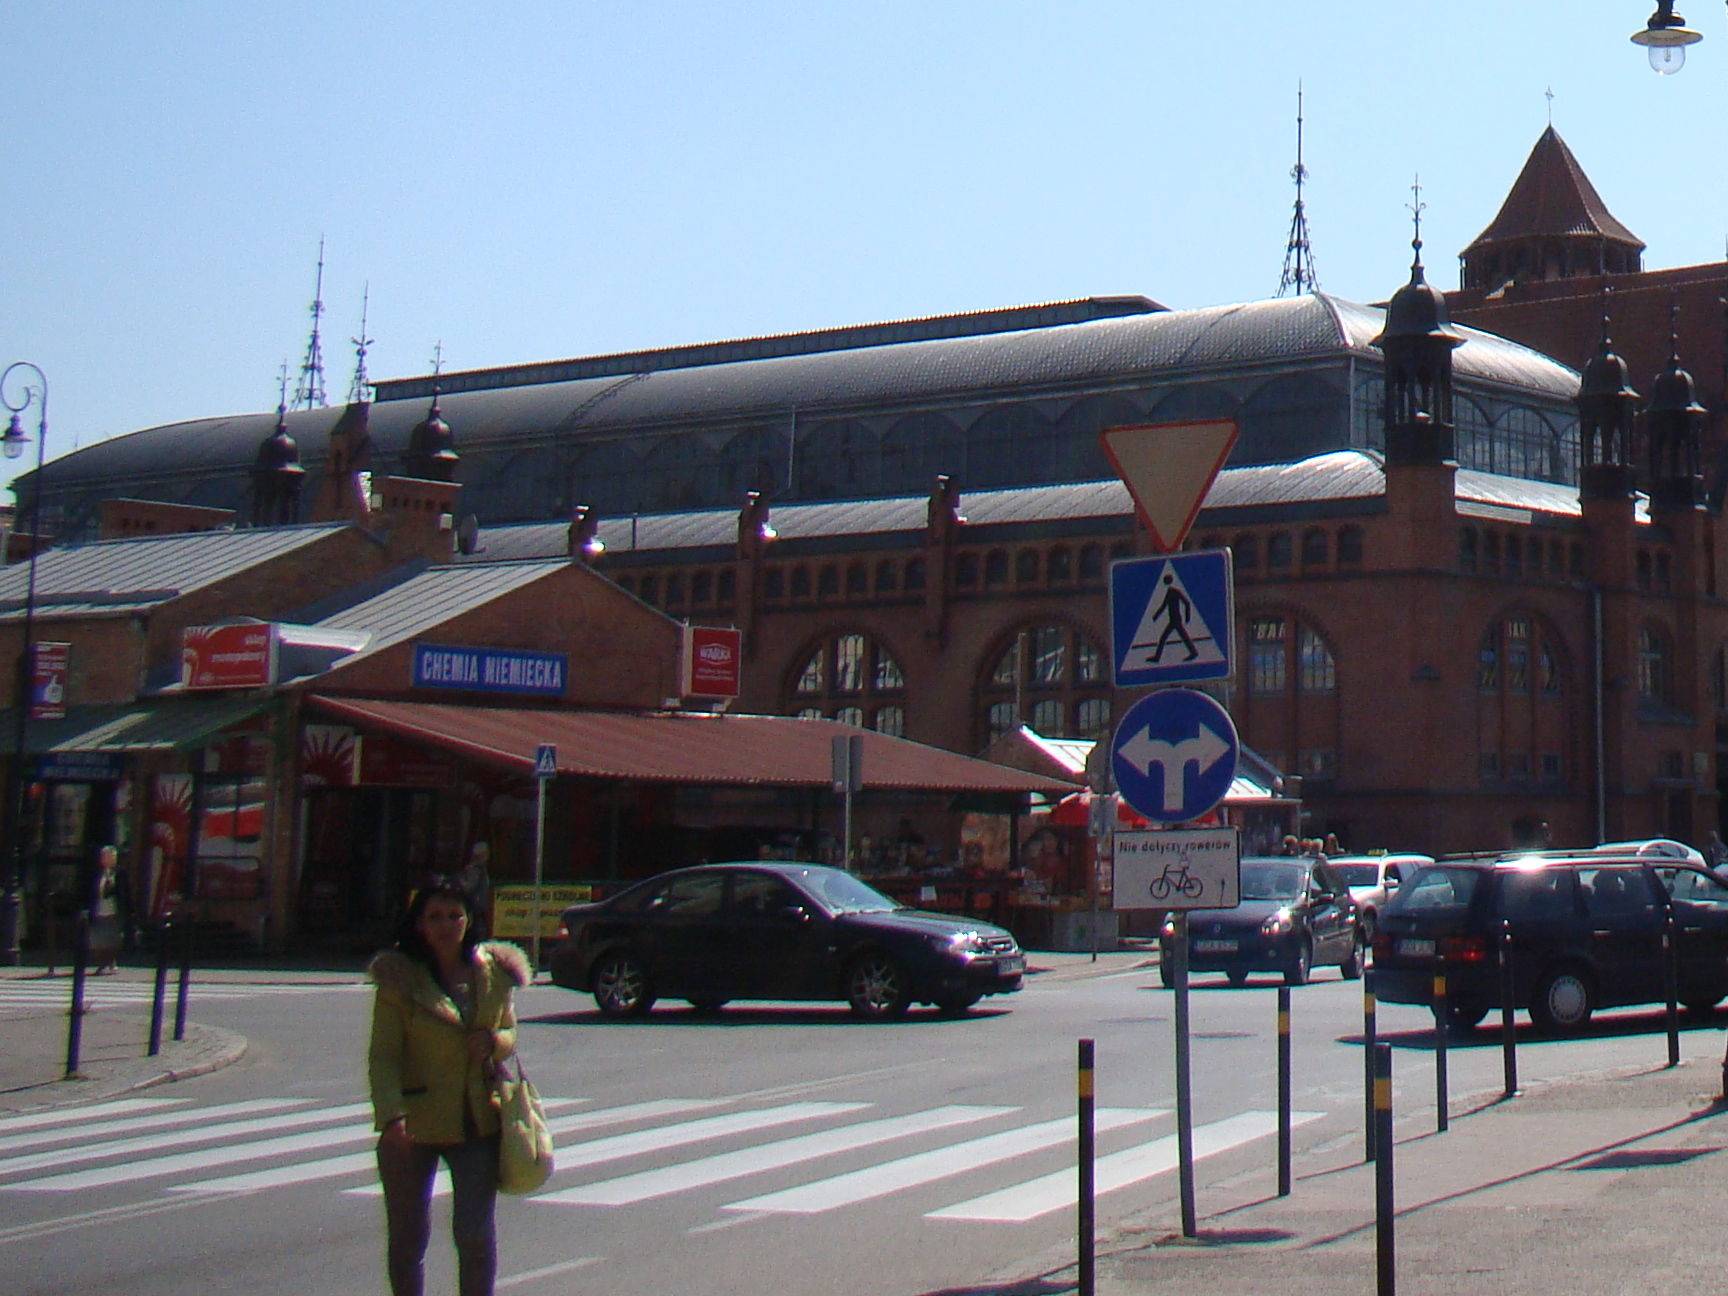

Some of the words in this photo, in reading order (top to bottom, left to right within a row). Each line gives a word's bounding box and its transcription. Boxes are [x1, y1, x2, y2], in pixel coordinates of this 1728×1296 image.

[423, 651, 479, 682] CHEMIA
[484, 655, 562, 688] NIEMIECKA
[1119, 840, 1137, 853] Nie
[1141, 839, 1181, 855] dotyczy
[1184, 840, 1231, 852] rowerów
